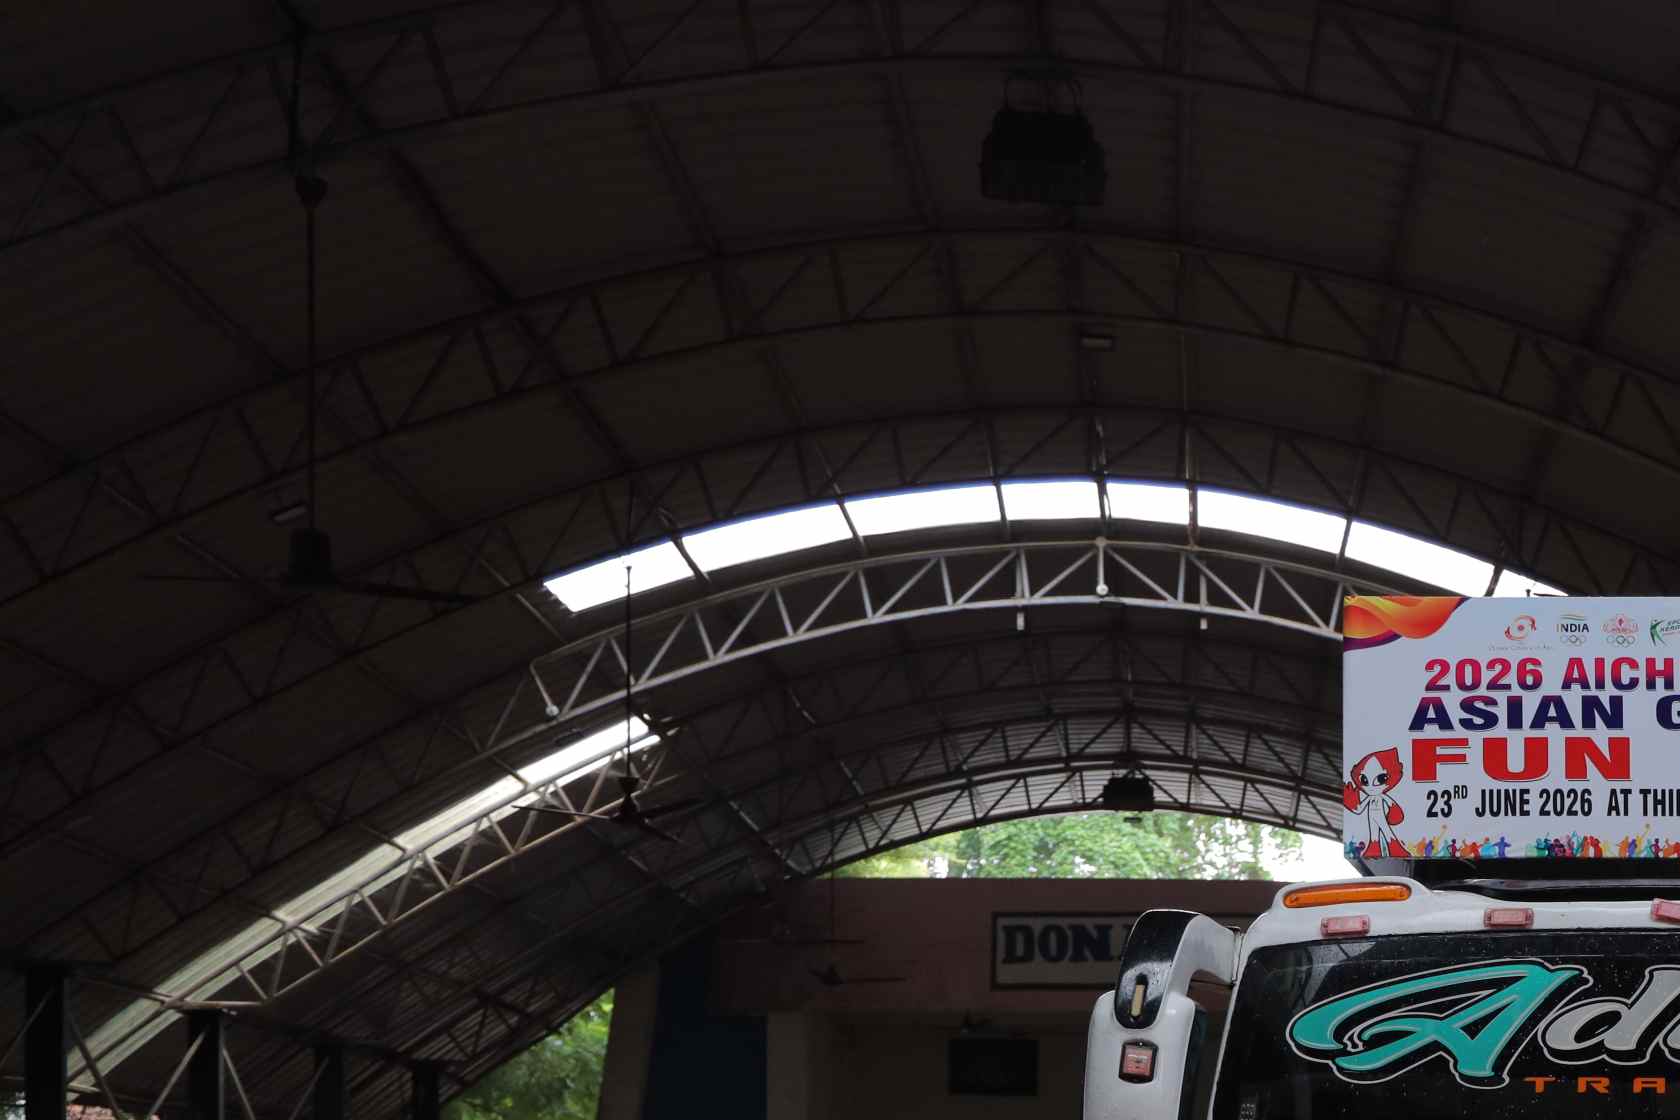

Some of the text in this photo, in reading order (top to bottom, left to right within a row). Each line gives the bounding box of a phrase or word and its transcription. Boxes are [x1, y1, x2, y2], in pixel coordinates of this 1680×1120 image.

[1556, 623, 1590, 633] INDIA
[1424, 657, 1543, 691] 2026
[1408, 695, 1625, 731] ASIAN
[1411, 737, 1631, 782] FUN
[1475, 789, 1531, 818] JUNE
[1539, 788, 1593, 817] 2026
[1607, 788, 1636, 817] AT
[1002, 924, 1132, 962] DON
